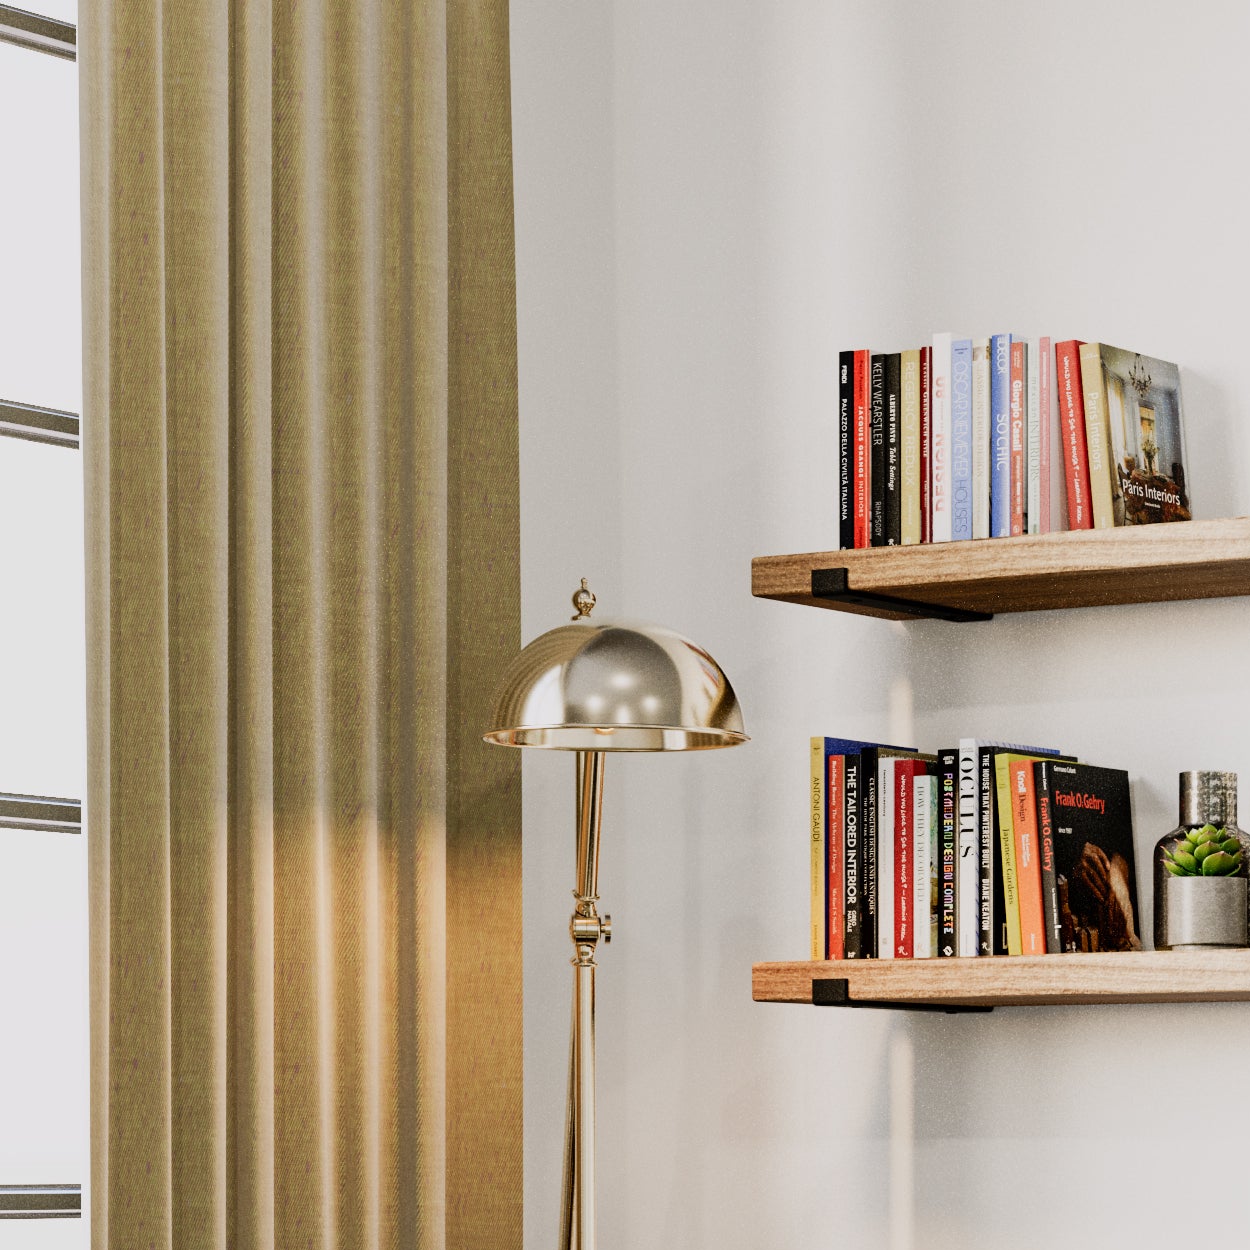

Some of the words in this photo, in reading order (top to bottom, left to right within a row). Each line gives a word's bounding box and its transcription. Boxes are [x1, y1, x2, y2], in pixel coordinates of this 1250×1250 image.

[873, 362, 882, 388] KELLY
[954, 360, 968, 411] OSCAR
[905, 361, 916, 431] REGENCY
[1011, 380, 1022, 418] Giorgio
[1088, 392, 1100, 420] Paris
[872, 390, 883, 445] WEARSTLER
[996, 414, 1008, 434] SO
[954, 411, 968, 477] NIEMEYER
[1013, 420, 1022, 451] Casali
[1030, 420, 1040, 480] INTERIORS
[1090, 422, 1103, 471] Interiors
[905, 435, 916, 487] REDUX
[996, 437, 1008, 471] CHIC
[841, 457, 849, 485] CIVILTÀ
[888, 465, 897, 491] Settings
[936, 433, 945, 512] DESIGN
[954, 479, 968, 533] HOUSES
[1122, 479, 1144, 497] Paris
[1145, 484, 1181, 506] Interiors
[982, 754, 990, 767] THE
[847, 766, 857, 788] THE
[982, 768, 990, 790] HOUSE
[1017, 771, 1027, 793] Knoll
[917, 786, 925, 808] HOW
[943, 773, 953, 840] POSTMODERN
[959, 757, 975, 858] OCULUS
[982, 791, 990, 809] THAT
[1018, 794, 1027, 822] Design
[1040, 797, 1050, 825] Frank
[1055, 789, 1076, 807] Frank
[1084, 793, 1105, 815] Gehry
[813, 813, 823, 842] GAUDÍ
[847, 790, 857, 847] TAILORED
[901, 827, 906, 836] TO
[917, 813, 925, 838] THEY
[982, 810, 990, 846] PINTEREST
[1042, 826, 1052, 838] O.
[943, 842, 953, 880] DESIGN
[982, 849, 990, 868] BUILT
[1003, 829, 1011, 867] Japanese
[1043, 837, 1055, 872] Gehry
[847, 850, 857, 905] INTERIOR
[917, 842, 925, 903] DECORATED
[1006, 868, 1014, 905] Gardens
[982, 879, 990, 900] DIANE
[943, 882, 954, 935] COMPLETE
[982, 902, 990, 930] KEATON
